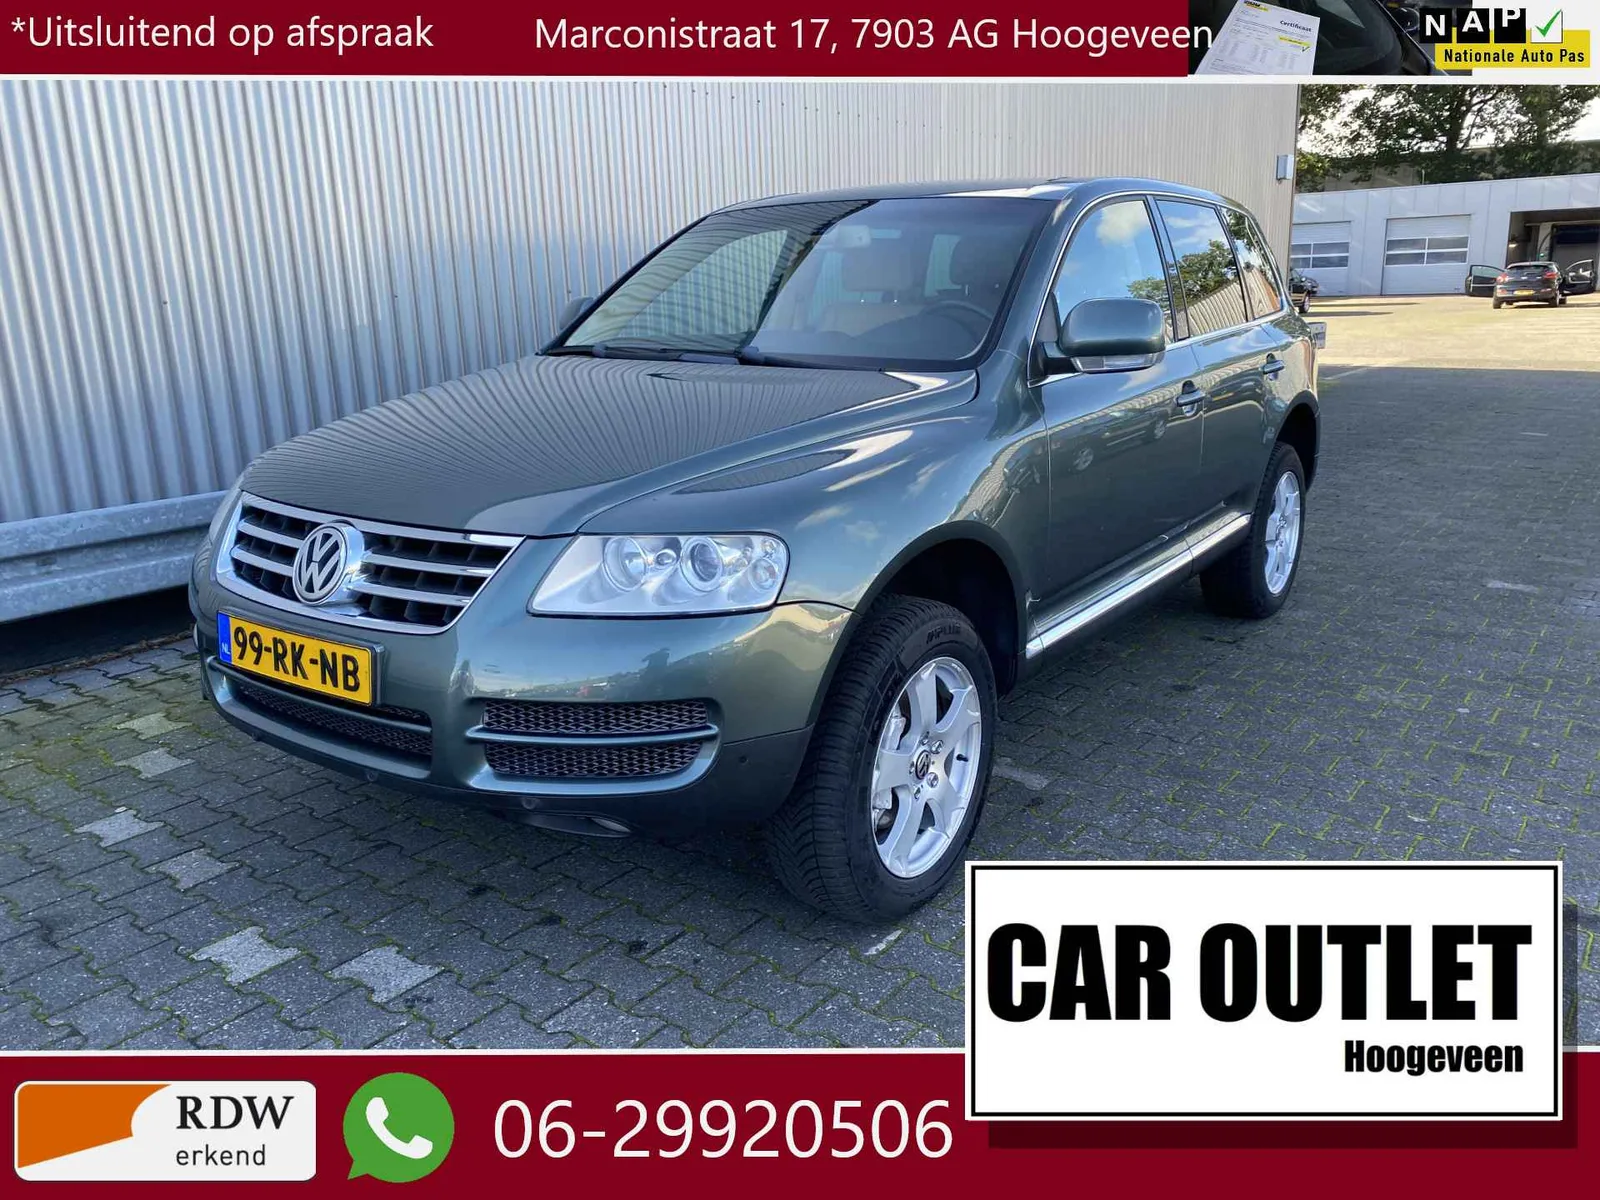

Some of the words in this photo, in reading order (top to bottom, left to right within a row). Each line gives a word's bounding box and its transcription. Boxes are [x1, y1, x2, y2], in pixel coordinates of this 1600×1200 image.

[298, 529, 344, 600] VW
[221, 642, 231, 655] NL
[234, 626, 361, 692] 99-RK-NB
